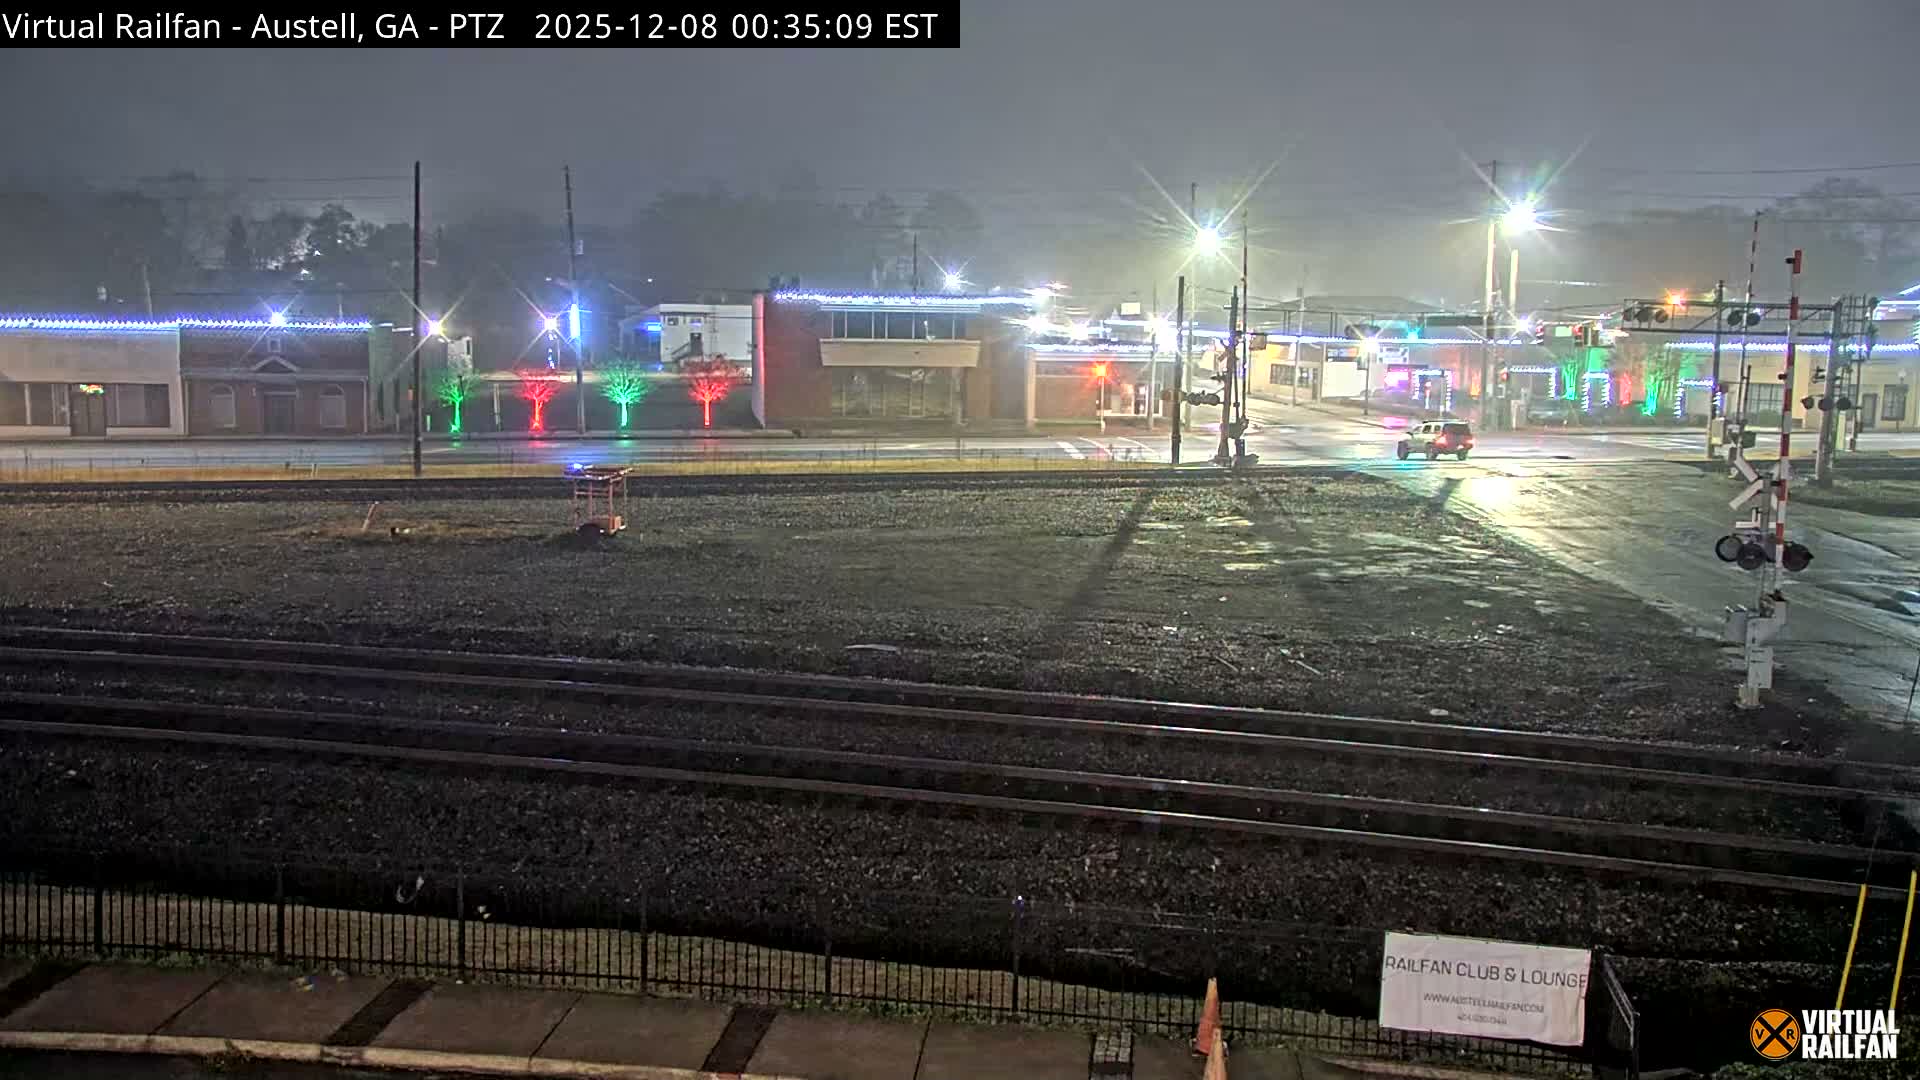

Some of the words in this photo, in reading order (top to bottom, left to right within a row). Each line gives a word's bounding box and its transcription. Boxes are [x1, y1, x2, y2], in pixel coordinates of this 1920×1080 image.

[1385, 955, 1452, 975] RAILFAN
[1456, 962, 1500, 981] CLUB
[1504, 966, 1517, 982] &
[1521, 967, 1588, 988] LOUNGE
